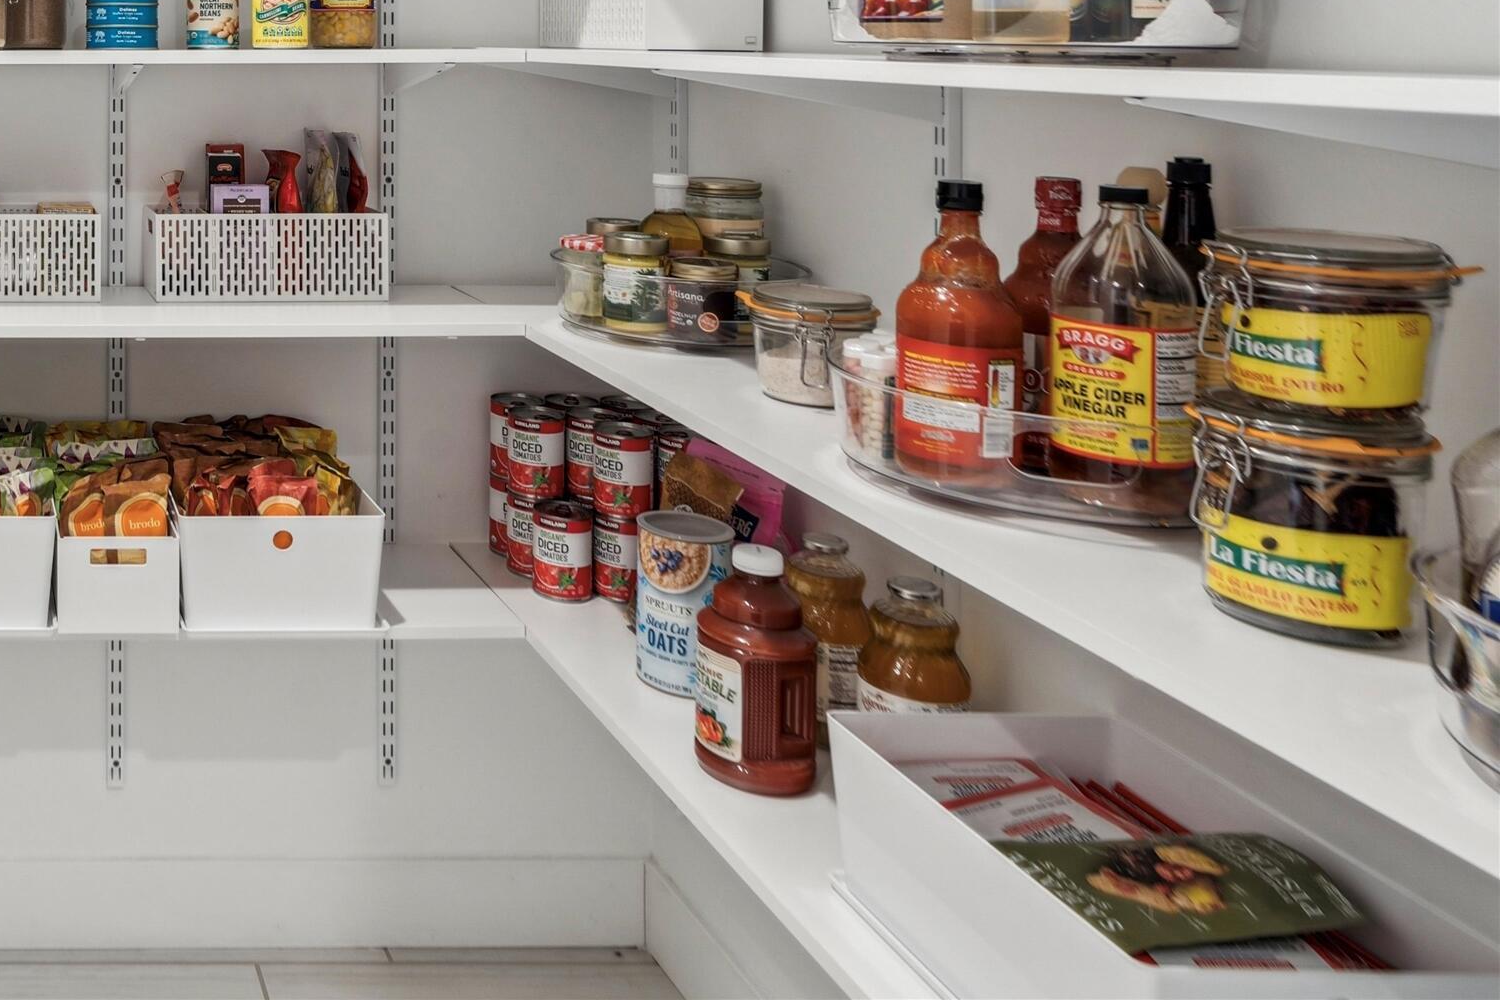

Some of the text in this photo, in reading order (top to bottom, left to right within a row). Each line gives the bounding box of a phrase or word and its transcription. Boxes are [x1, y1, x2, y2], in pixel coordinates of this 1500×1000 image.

[1062, 329, 1125, 351] BRAGG
[1233, 330, 1317, 367] Fiesta
[1066, 363, 1118, 379] ORGANIC
[1093, 386, 1146, 406] CIDER
[1061, 394, 1127, 419] VINEGAR
[514, 420, 540, 429] KIRKLAND
[571, 421, 594, 429] KIRKLAN
[514, 431, 540, 442] ORGANIC
[596, 436, 620, 446] KIRKLAND
[512, 440, 543, 454] DICED
[569, 440, 594, 454] DICE
[596, 448, 620, 459] ORGANIC
[513, 450, 542, 461] TOMATOES
[595, 455, 623, 471] DICED
[129, 517, 160, 530] brodo
[512, 518, 534, 532] DICE
[540, 517, 567, 528] KIRKLAND
[513, 528, 534, 540] TOMATO
[540, 529, 566, 542] ORGANIC
[537, 537, 569, 554] DICED
[539, 548, 569, 562] TOMATOES
[1209, 534, 1341, 591] La Fiesta
[645, 613, 690, 637] Steel Cut
[647, 628, 688, 657] OATS
